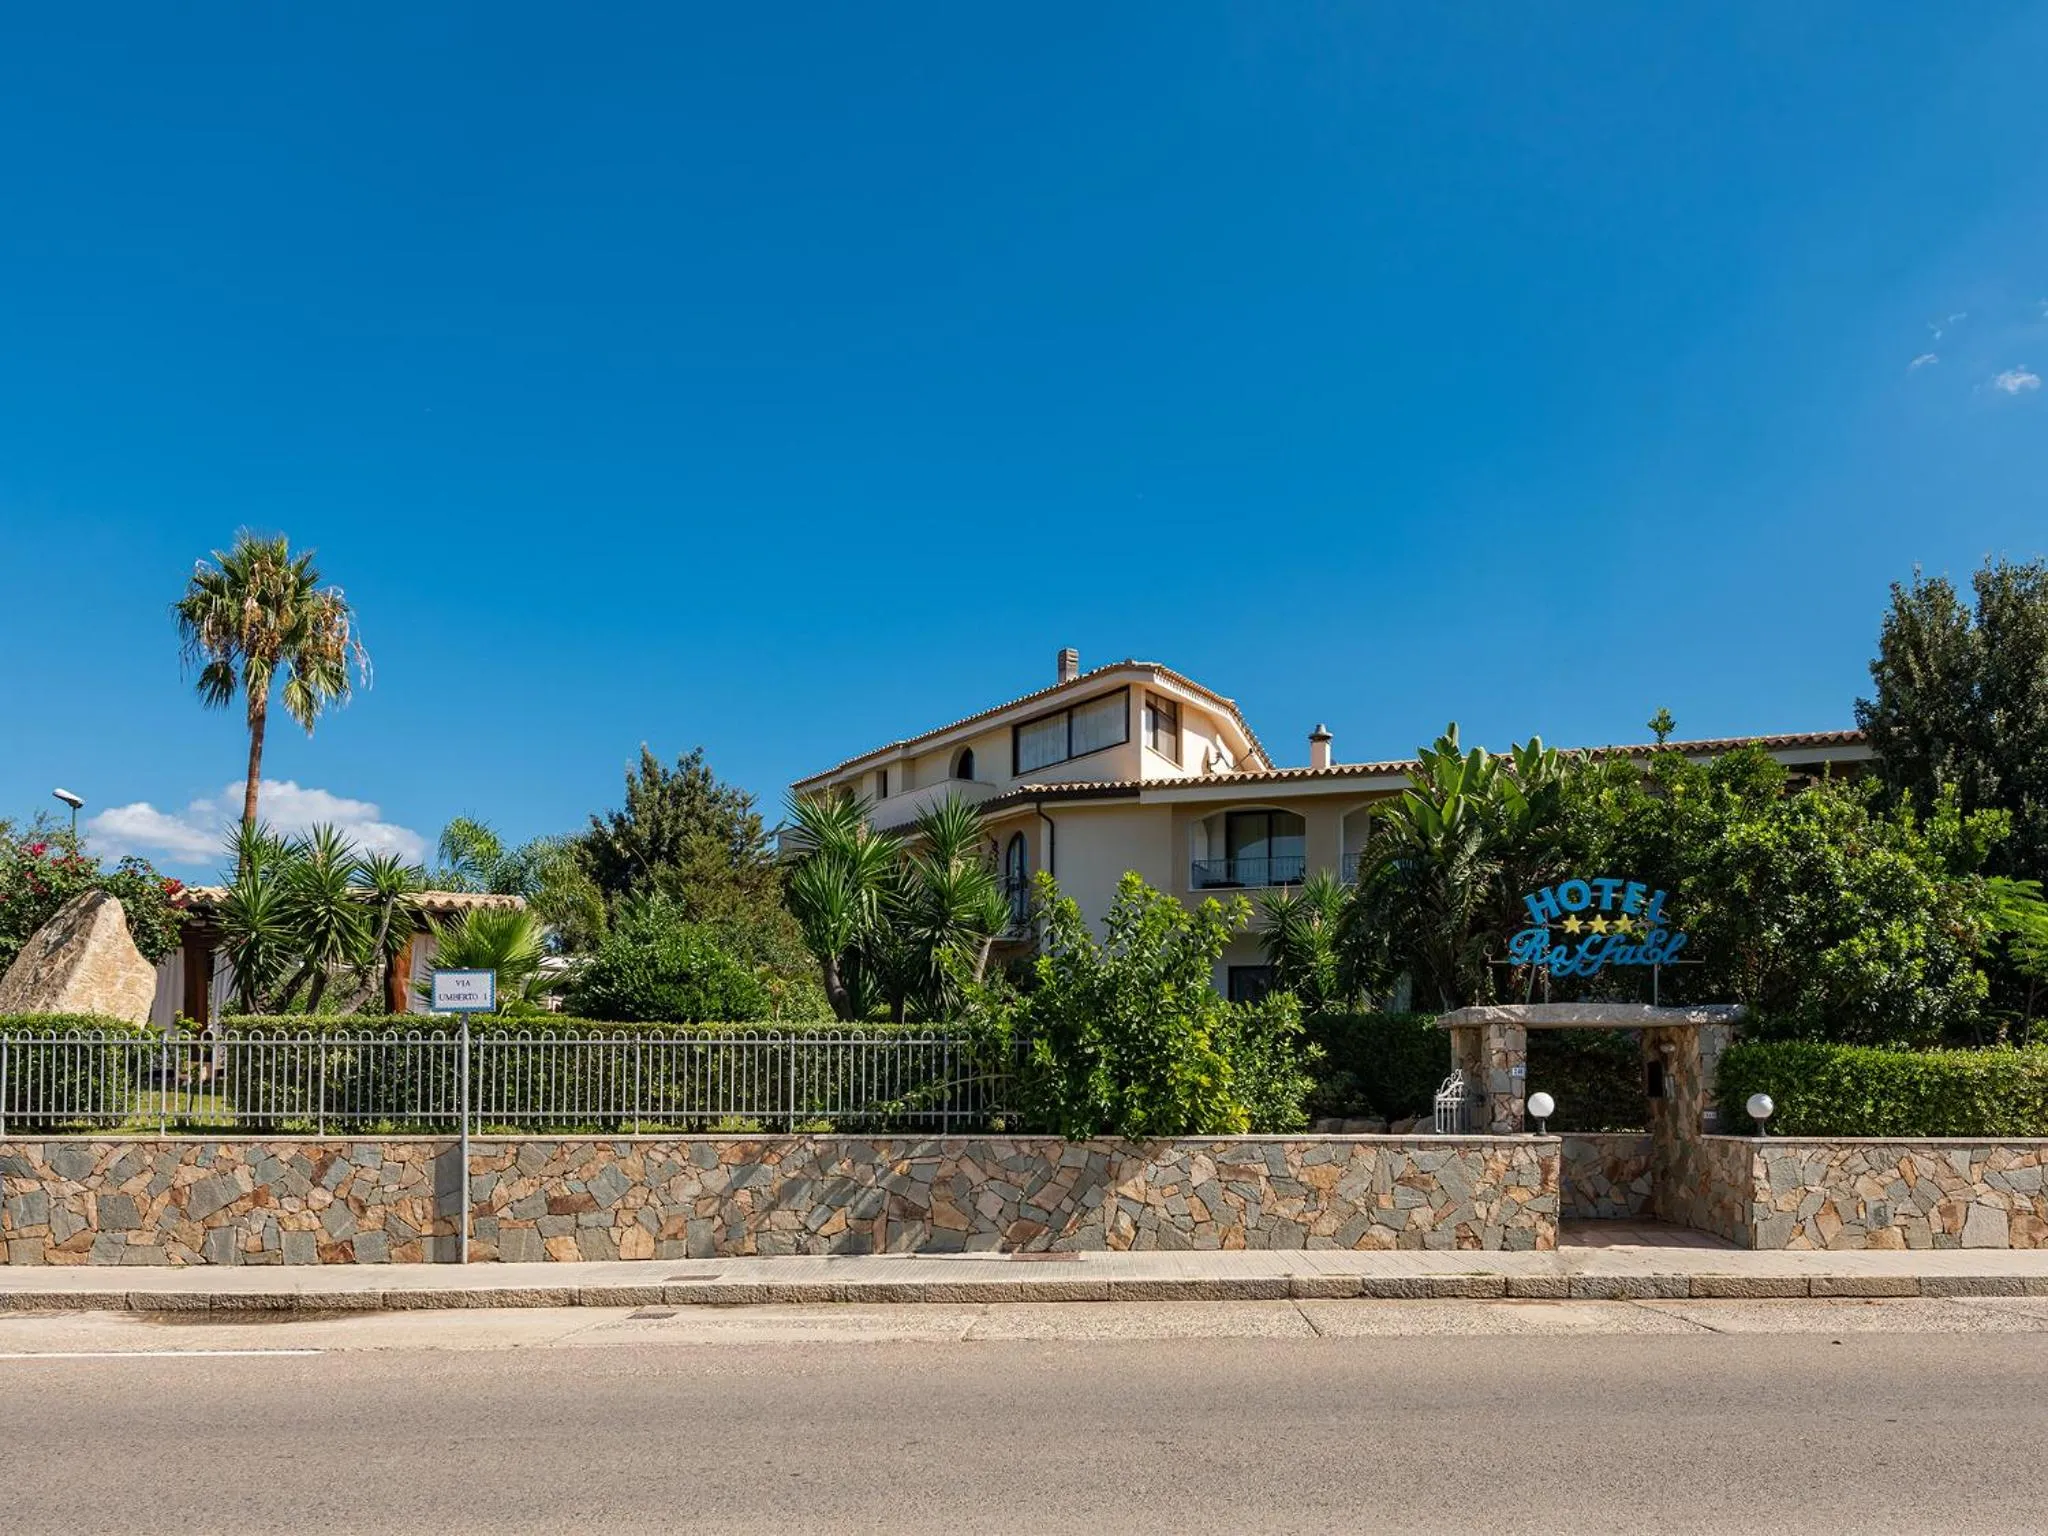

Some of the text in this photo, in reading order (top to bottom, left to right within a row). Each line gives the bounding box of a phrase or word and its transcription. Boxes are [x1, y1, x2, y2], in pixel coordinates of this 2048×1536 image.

[1523, 877, 1669, 925] HOTEL
[455, 979, 471, 987] VIA
[439, 993, 479, 1001] UMBERTO
